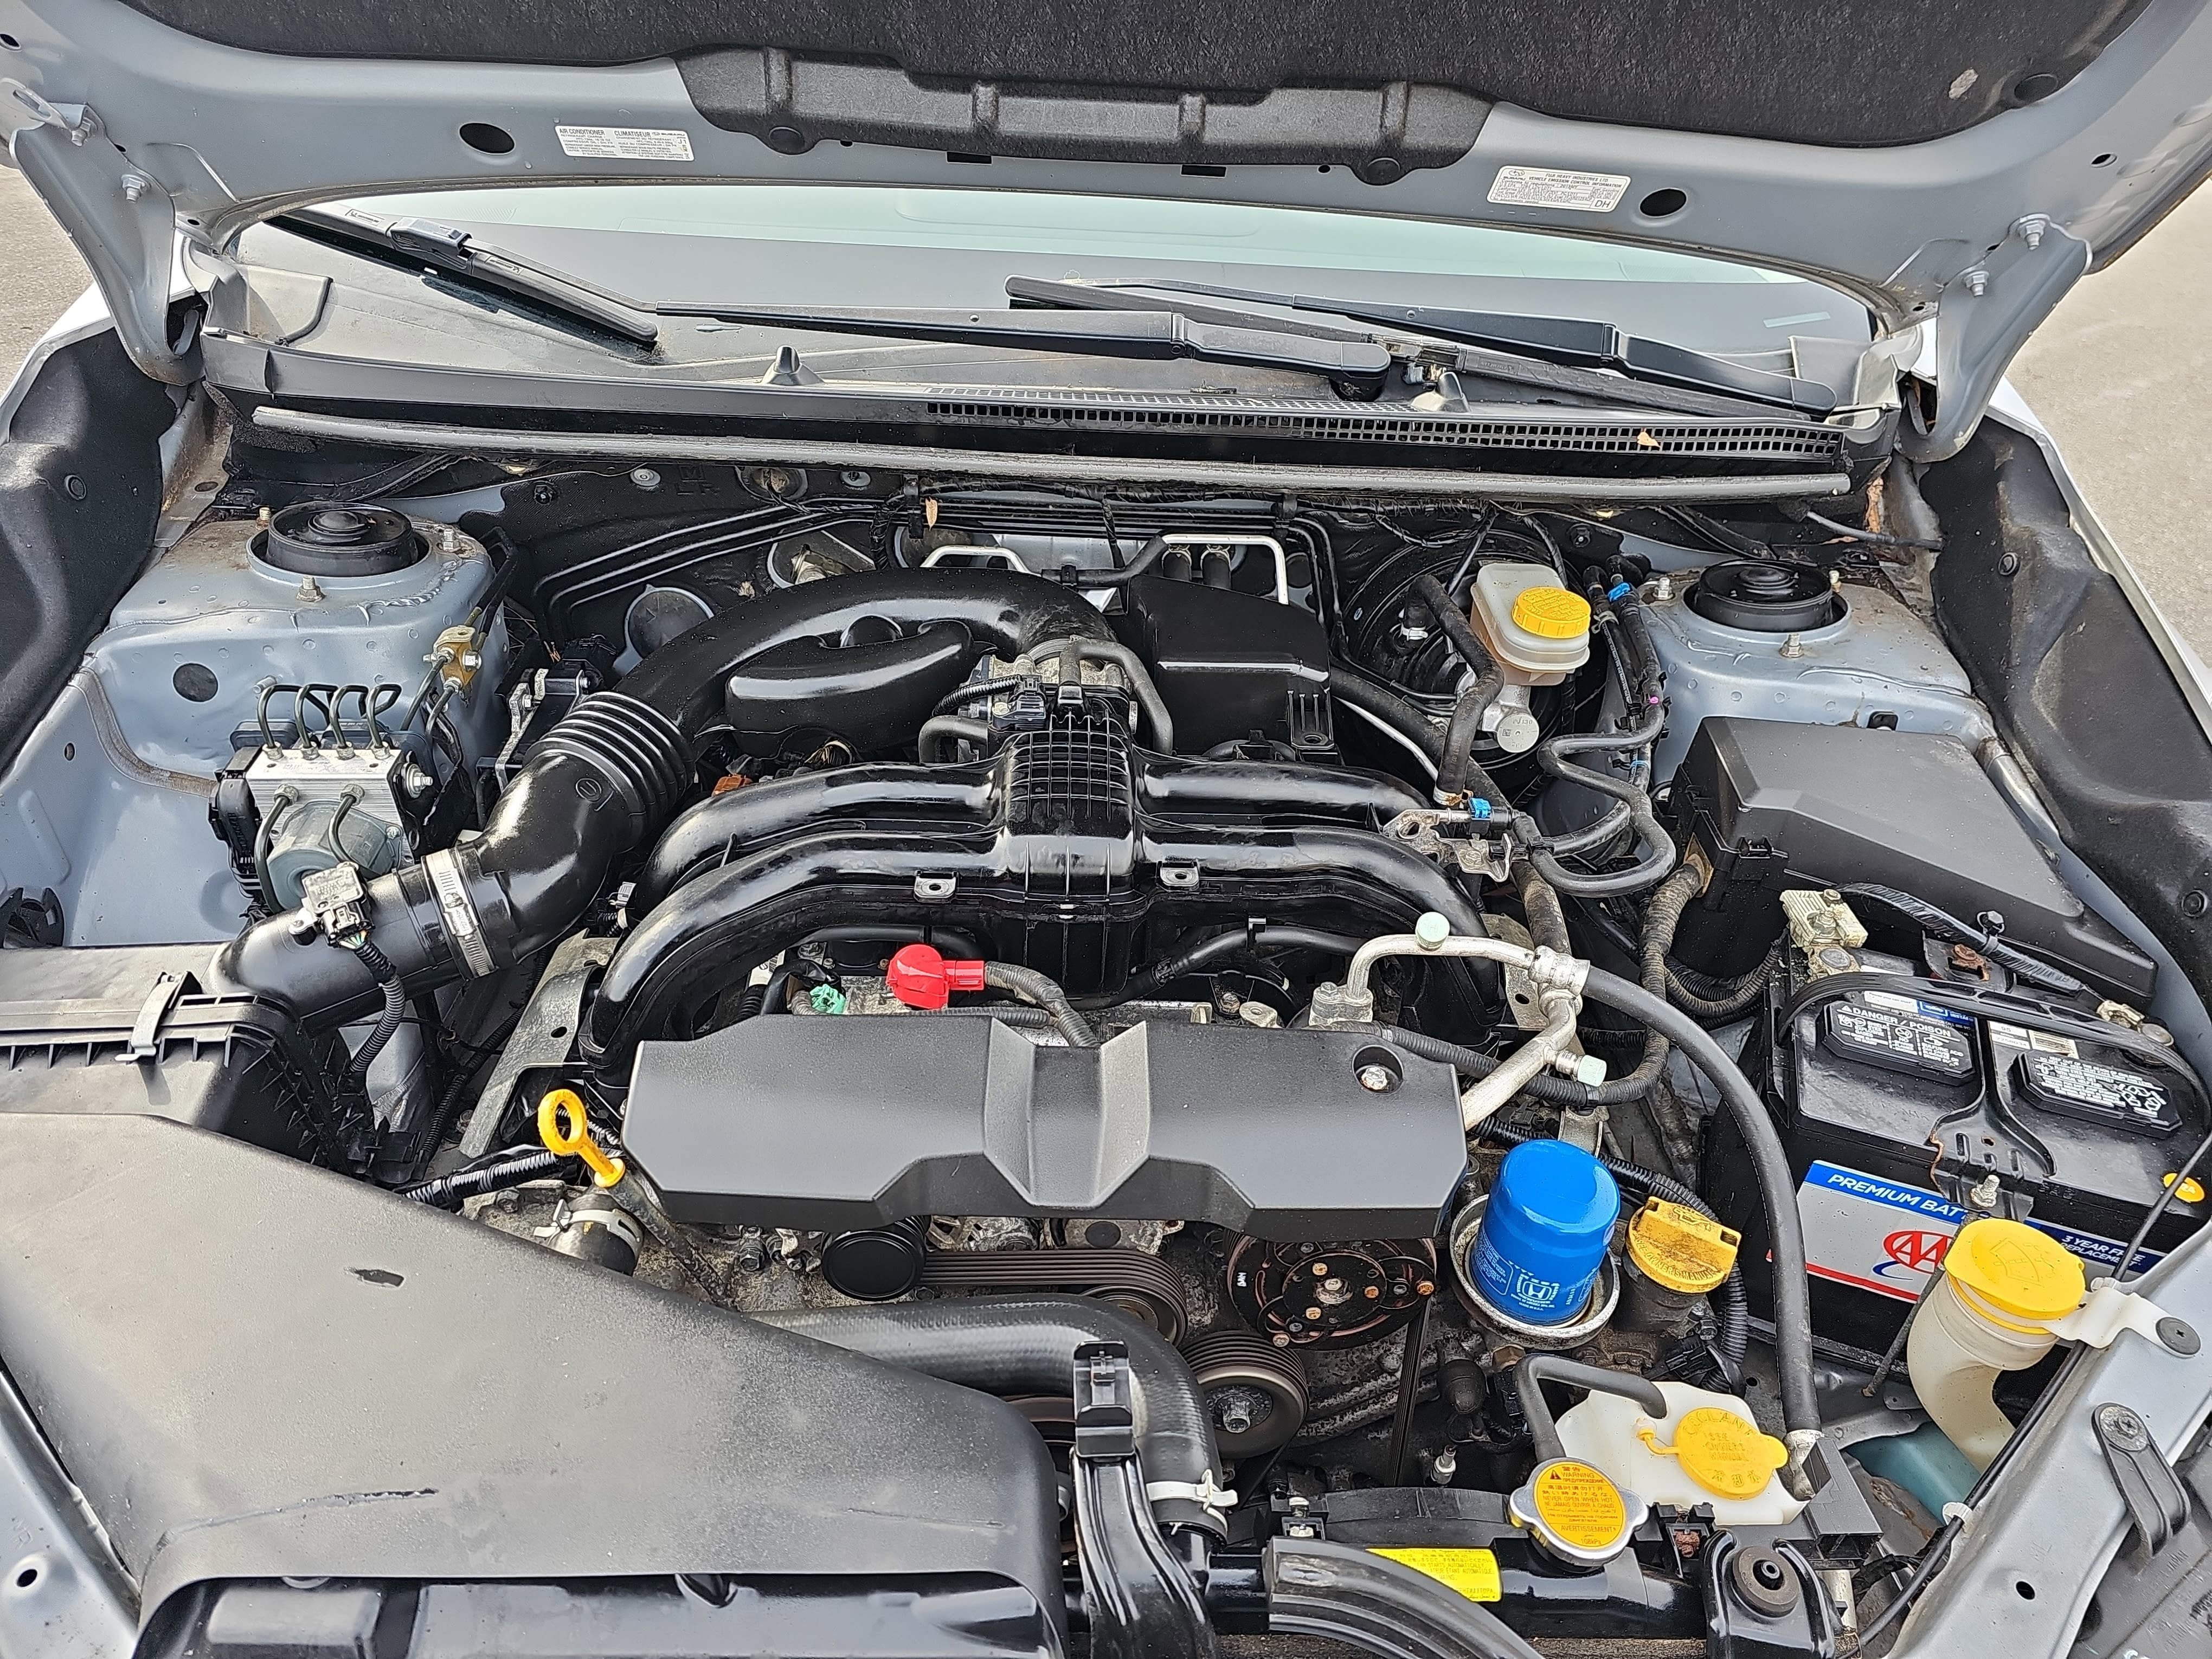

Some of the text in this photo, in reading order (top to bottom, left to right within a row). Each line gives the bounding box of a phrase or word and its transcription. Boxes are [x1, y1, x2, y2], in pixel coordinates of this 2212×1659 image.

[1594, 200, 1611, 208] DH
[1853, 1007, 1898, 1024] DANGER
[1909, 1021, 1951, 1037] POISON
[1828, 1174, 1921, 1206] PREMIUM
[1635, 1237, 1648, 1254] SEE
[1682, 1269, 1715, 1281] MANUAL
[2061, 1242, 2138, 1267] REPLACEMET
[2074, 1238, 2109, 1253] YEAR
[2108, 1248, 2146, 1262] FRE
[1683, 1410, 1757, 1436] COOLANT
